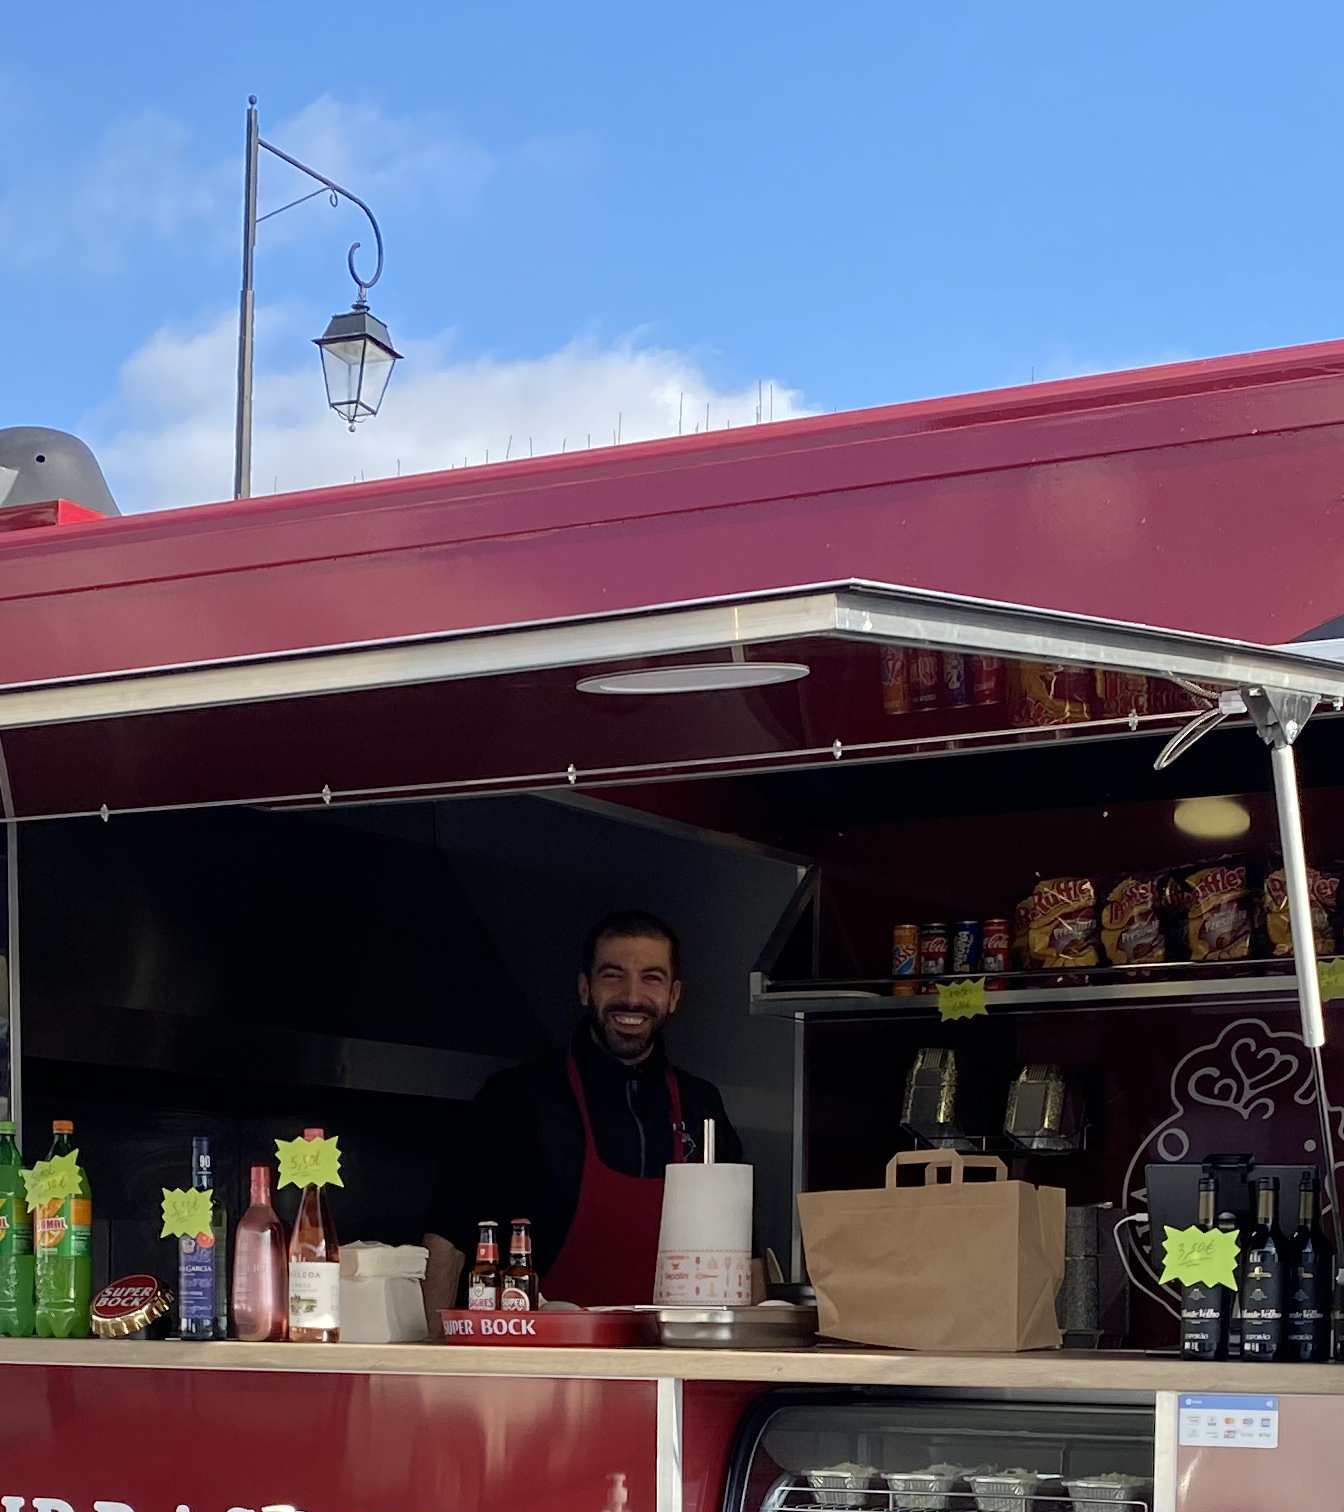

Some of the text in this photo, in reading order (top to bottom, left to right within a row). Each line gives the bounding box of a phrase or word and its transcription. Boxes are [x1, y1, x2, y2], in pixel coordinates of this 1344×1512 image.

[101, 1286, 154, 1297] SUPER
[96, 1297, 144, 1307] BOCK
[443, 1318, 537, 1336] SUPER BOCK
